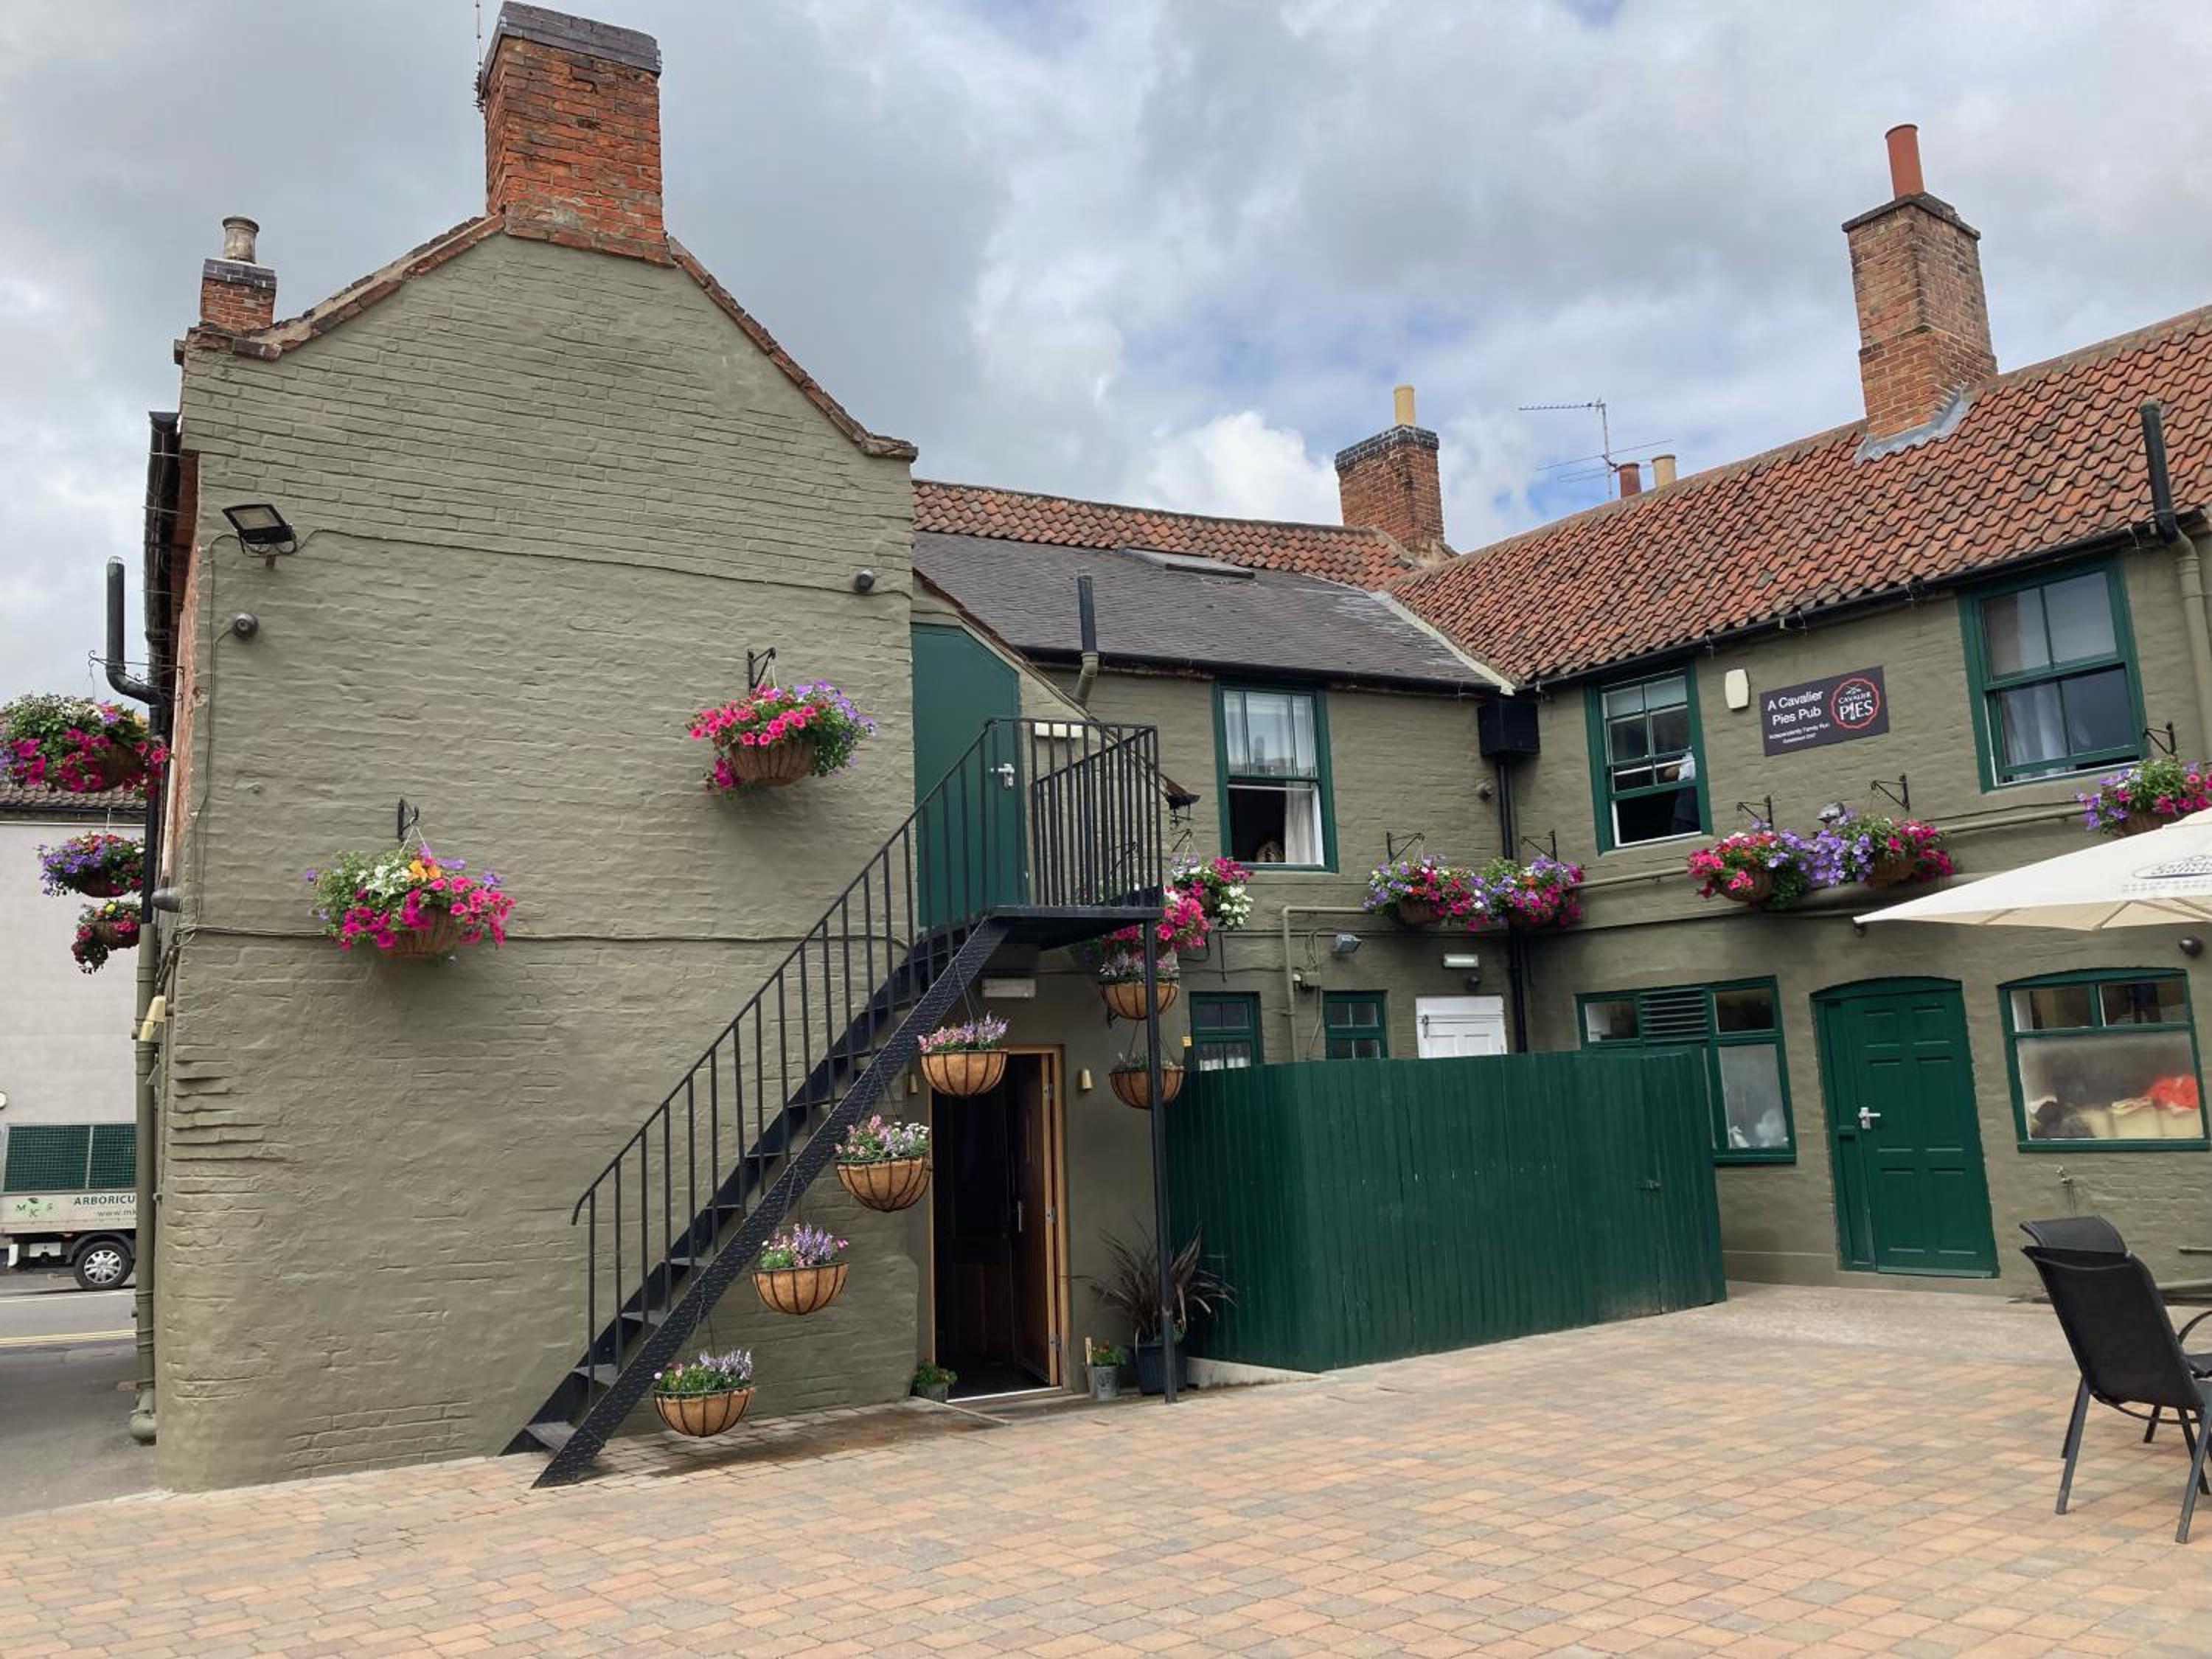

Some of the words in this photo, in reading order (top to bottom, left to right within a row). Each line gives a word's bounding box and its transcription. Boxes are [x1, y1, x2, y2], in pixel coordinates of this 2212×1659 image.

[1767, 699, 1777, 712] A
[1778, 691, 1823, 708] Cavalier
[1838, 691, 1871, 704] CAVALIER
[1772, 713, 1796, 726] Pies
[1798, 706, 1822, 720] Pub
[1840, 700, 1874, 720] PIES
[74, 1195, 135, 1206] ARBORICU
